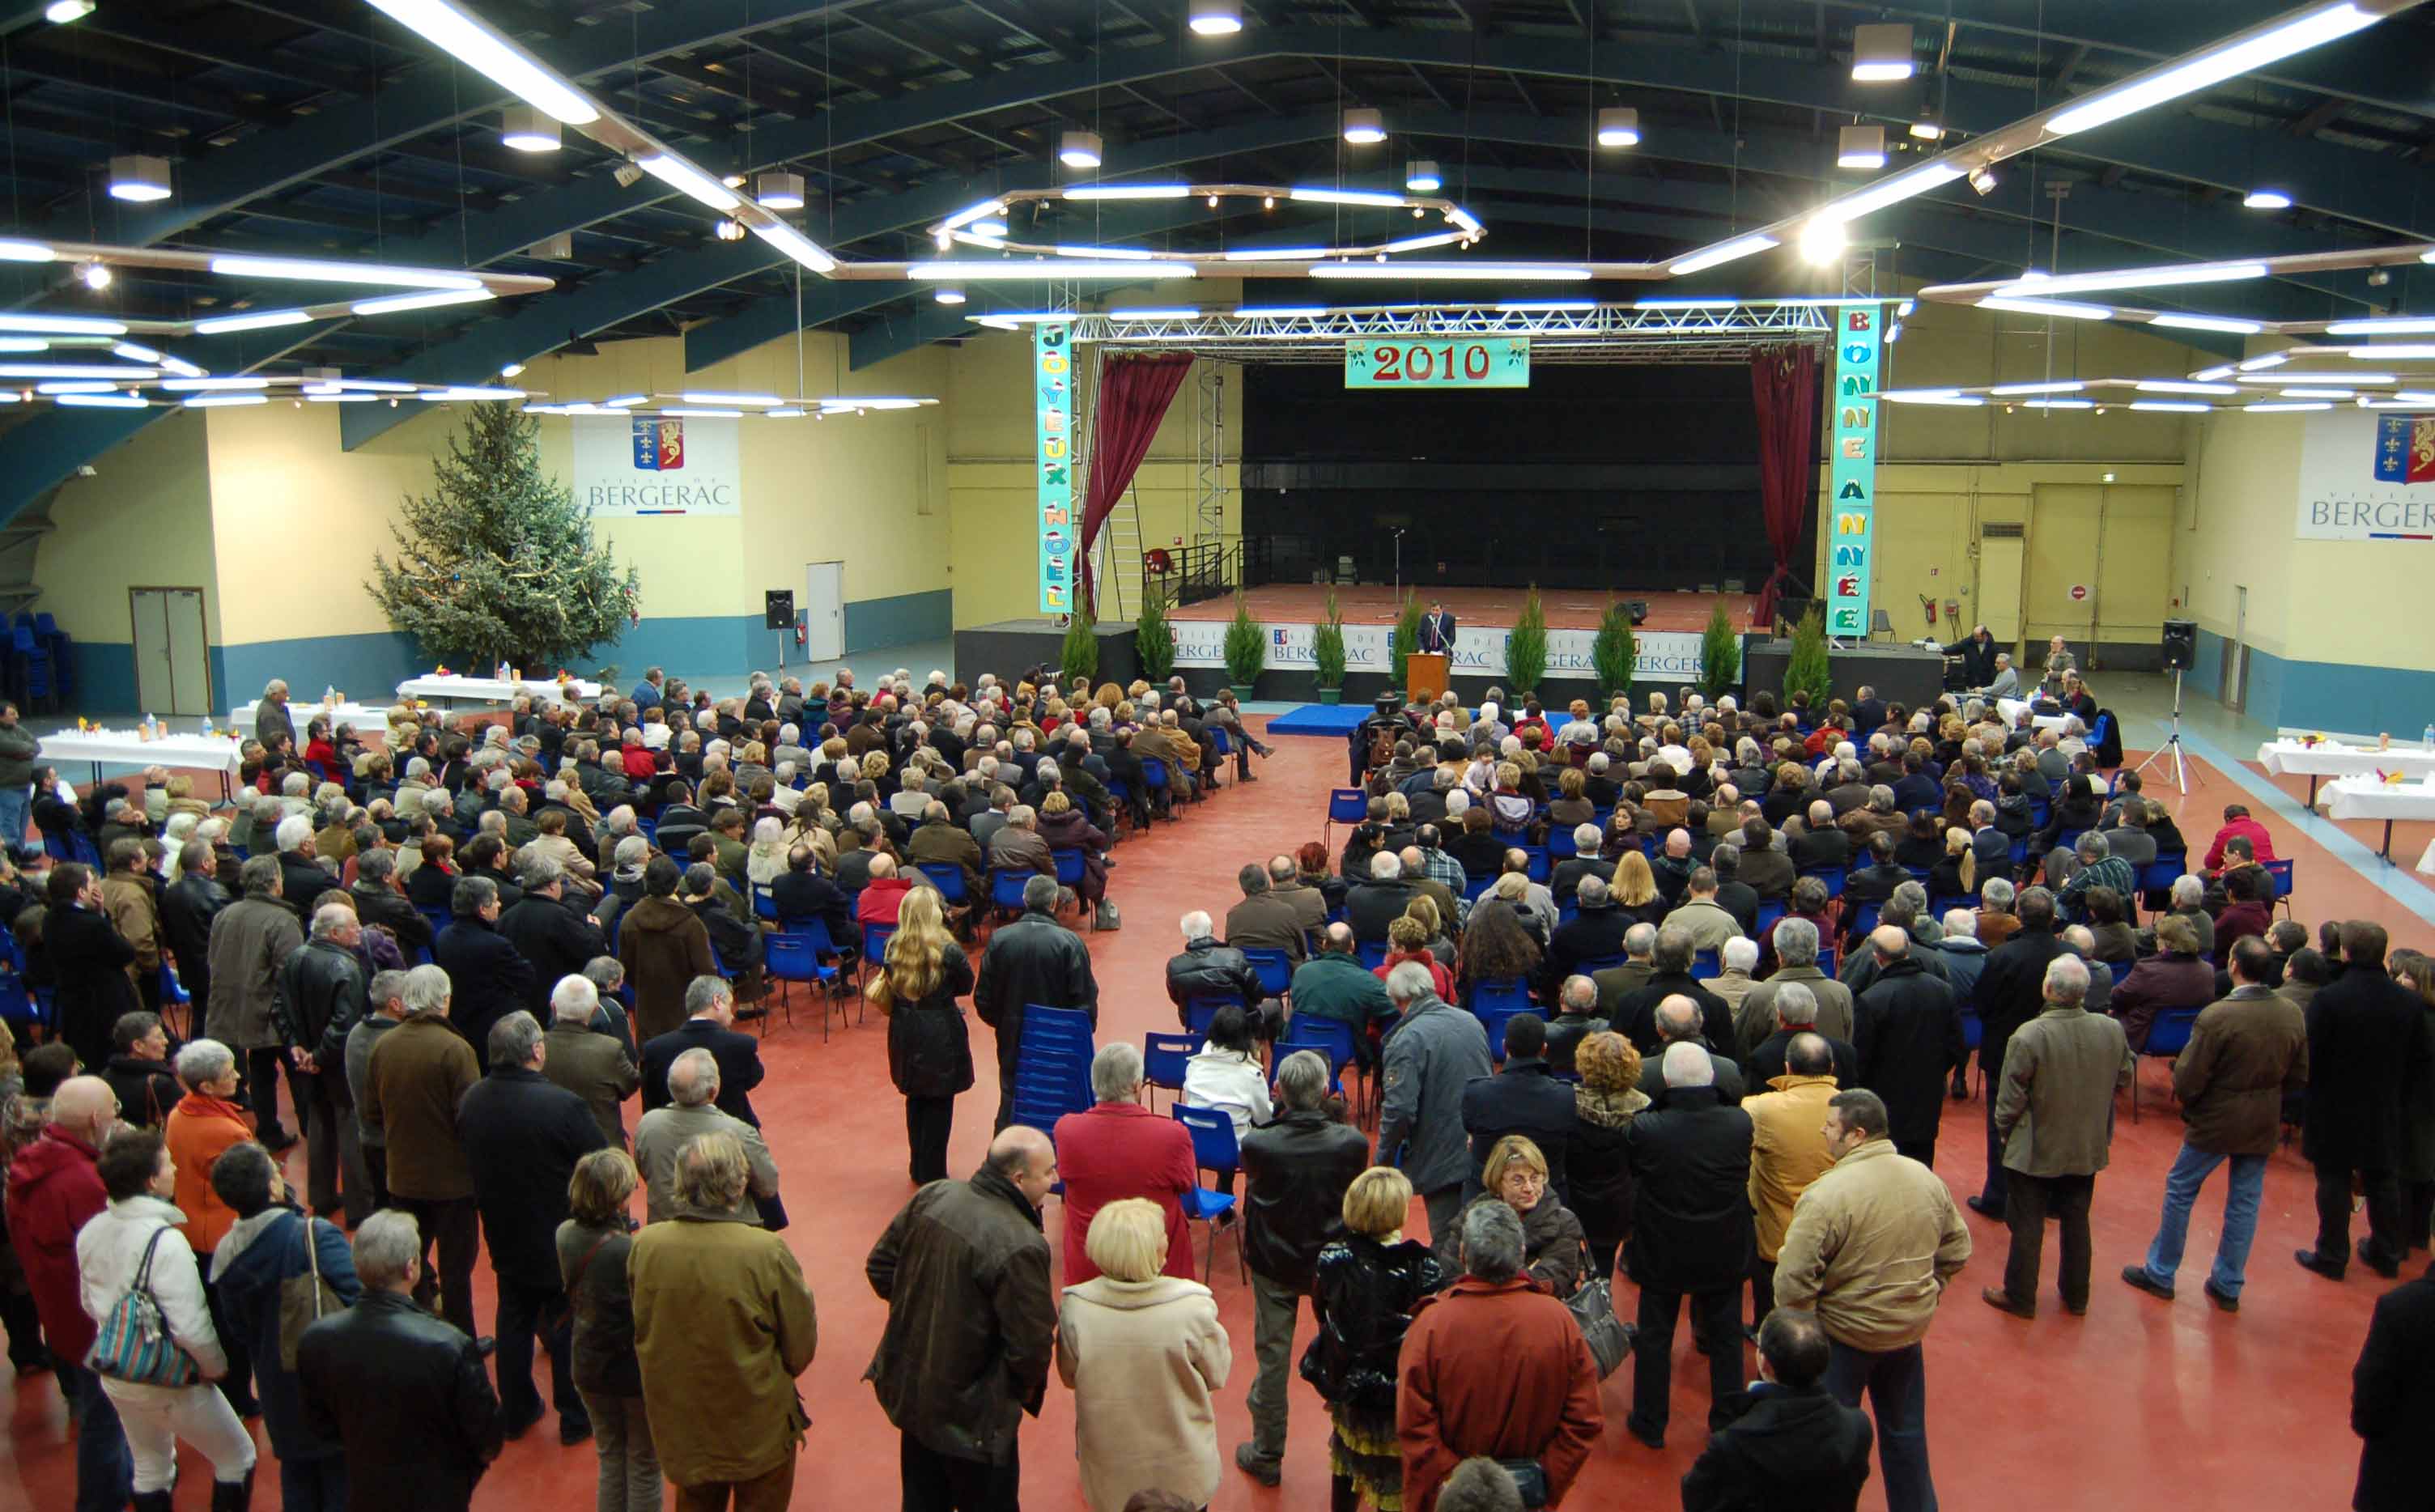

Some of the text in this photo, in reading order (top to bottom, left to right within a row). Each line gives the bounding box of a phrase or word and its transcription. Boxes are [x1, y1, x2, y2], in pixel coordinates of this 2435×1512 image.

[1373, 346, 1489, 380] 2010
[1042, 325, 1069, 485] JOYEUX
[1835, 311, 1872, 629] BONNE ANNÉE
[590, 486, 731, 506] BERGERAC
[1176, 644, 1225, 657] ERGE
[1545, 653, 1595, 667] GERA
[1639, 656, 1703, 671] ERGER
